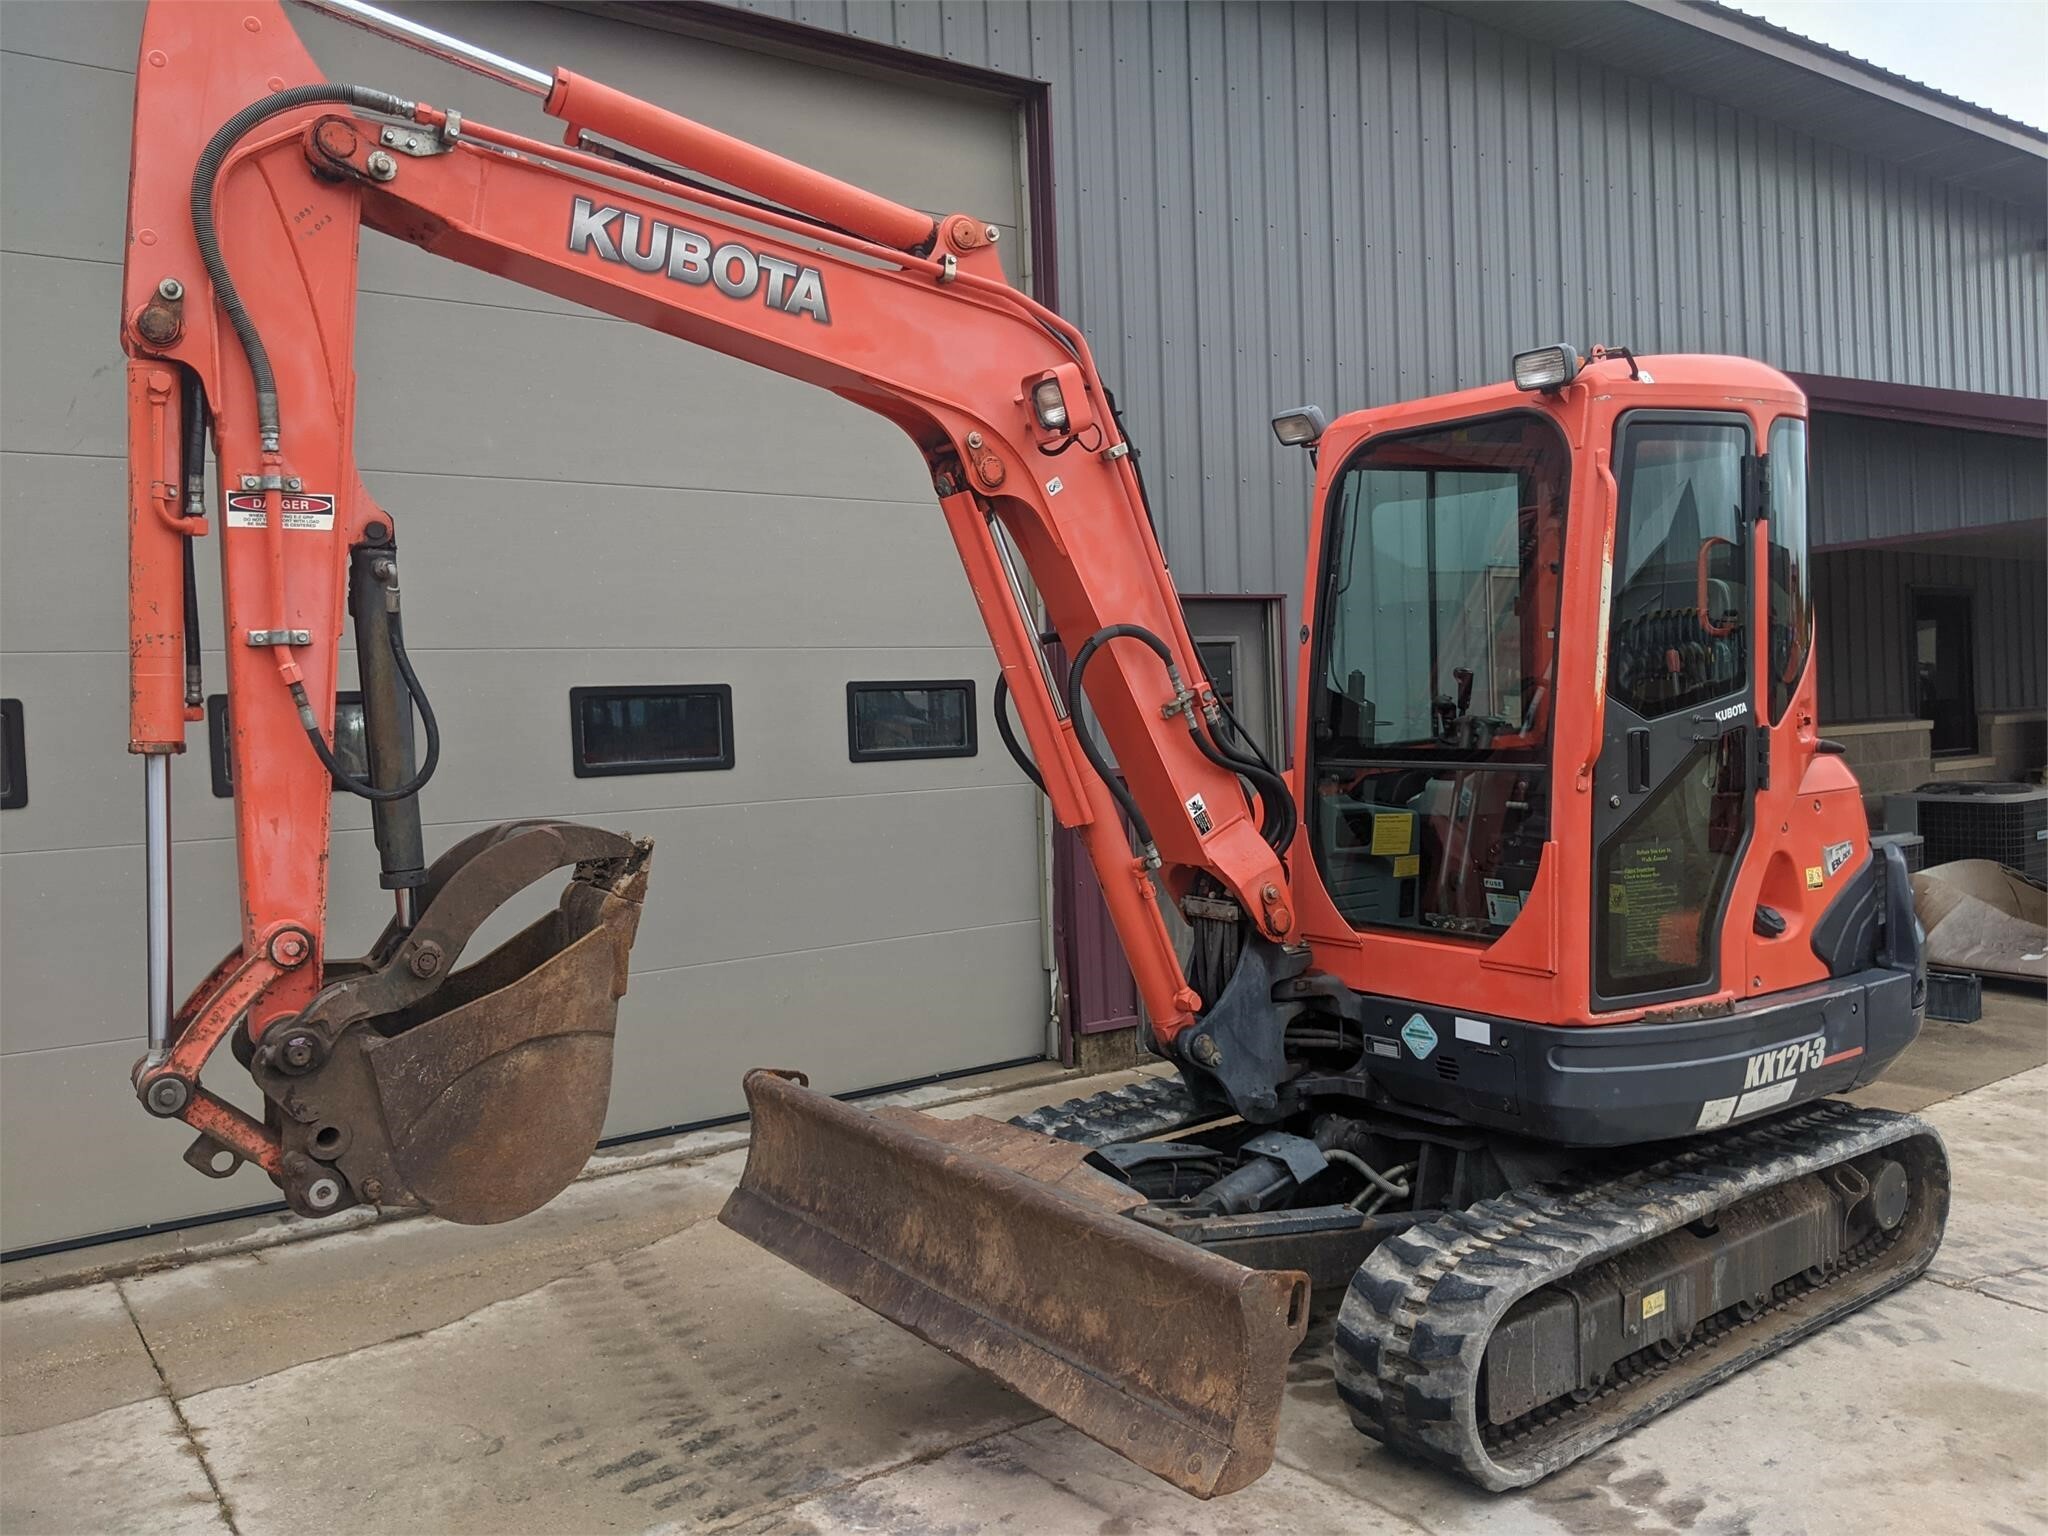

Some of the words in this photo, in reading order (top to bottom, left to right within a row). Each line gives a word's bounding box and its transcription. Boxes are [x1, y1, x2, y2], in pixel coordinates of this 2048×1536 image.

[568, 197, 831, 324] KUBOTA
[1715, 702, 1747, 721] KUBOTA
[1744, 1036, 1826, 1089] KX121-3
